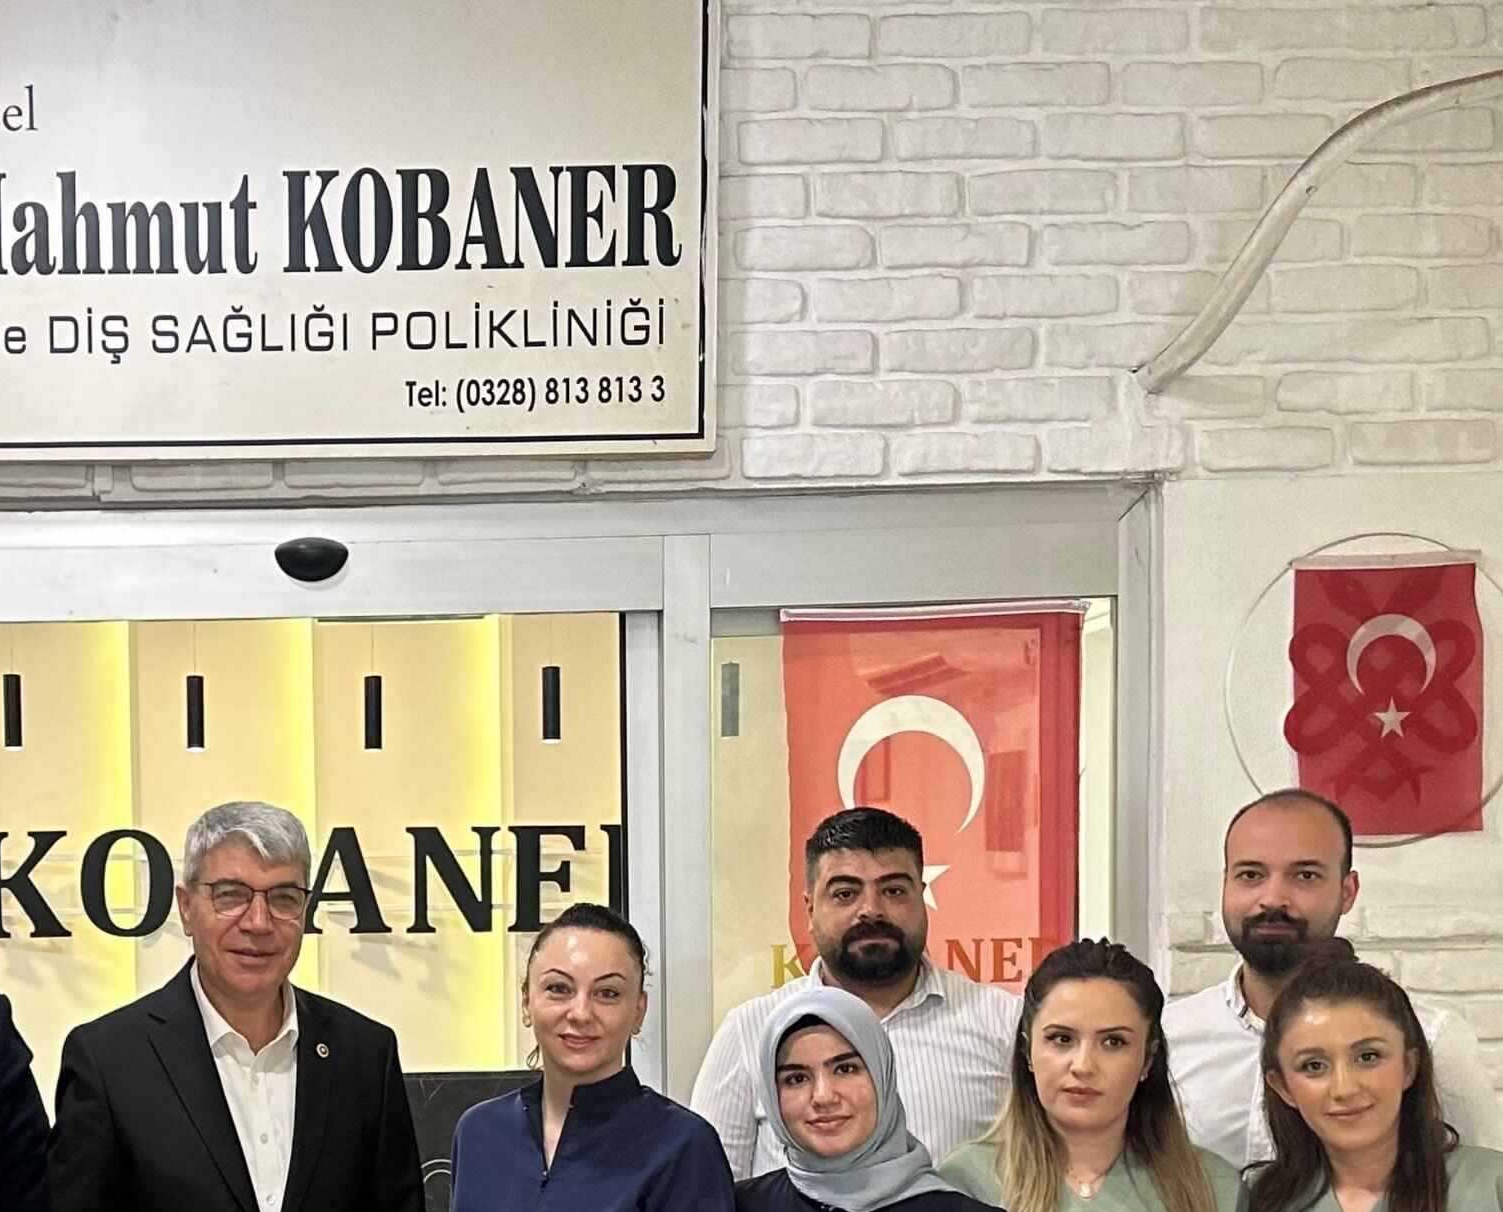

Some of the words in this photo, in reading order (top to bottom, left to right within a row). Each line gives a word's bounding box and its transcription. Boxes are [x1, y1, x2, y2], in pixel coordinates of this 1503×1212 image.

[282, 163, 683, 274] KOBANER
[49, 307, 130, 365] DİŞ
[151, 304, 348, 354] SAĞLIĞI
[371, 297, 666, 351] POLİKLİNİĞİ
[405, 379, 447, 408] Tel:
[455, 376, 537, 414] (0328)
[544, 376, 590, 405] 813
